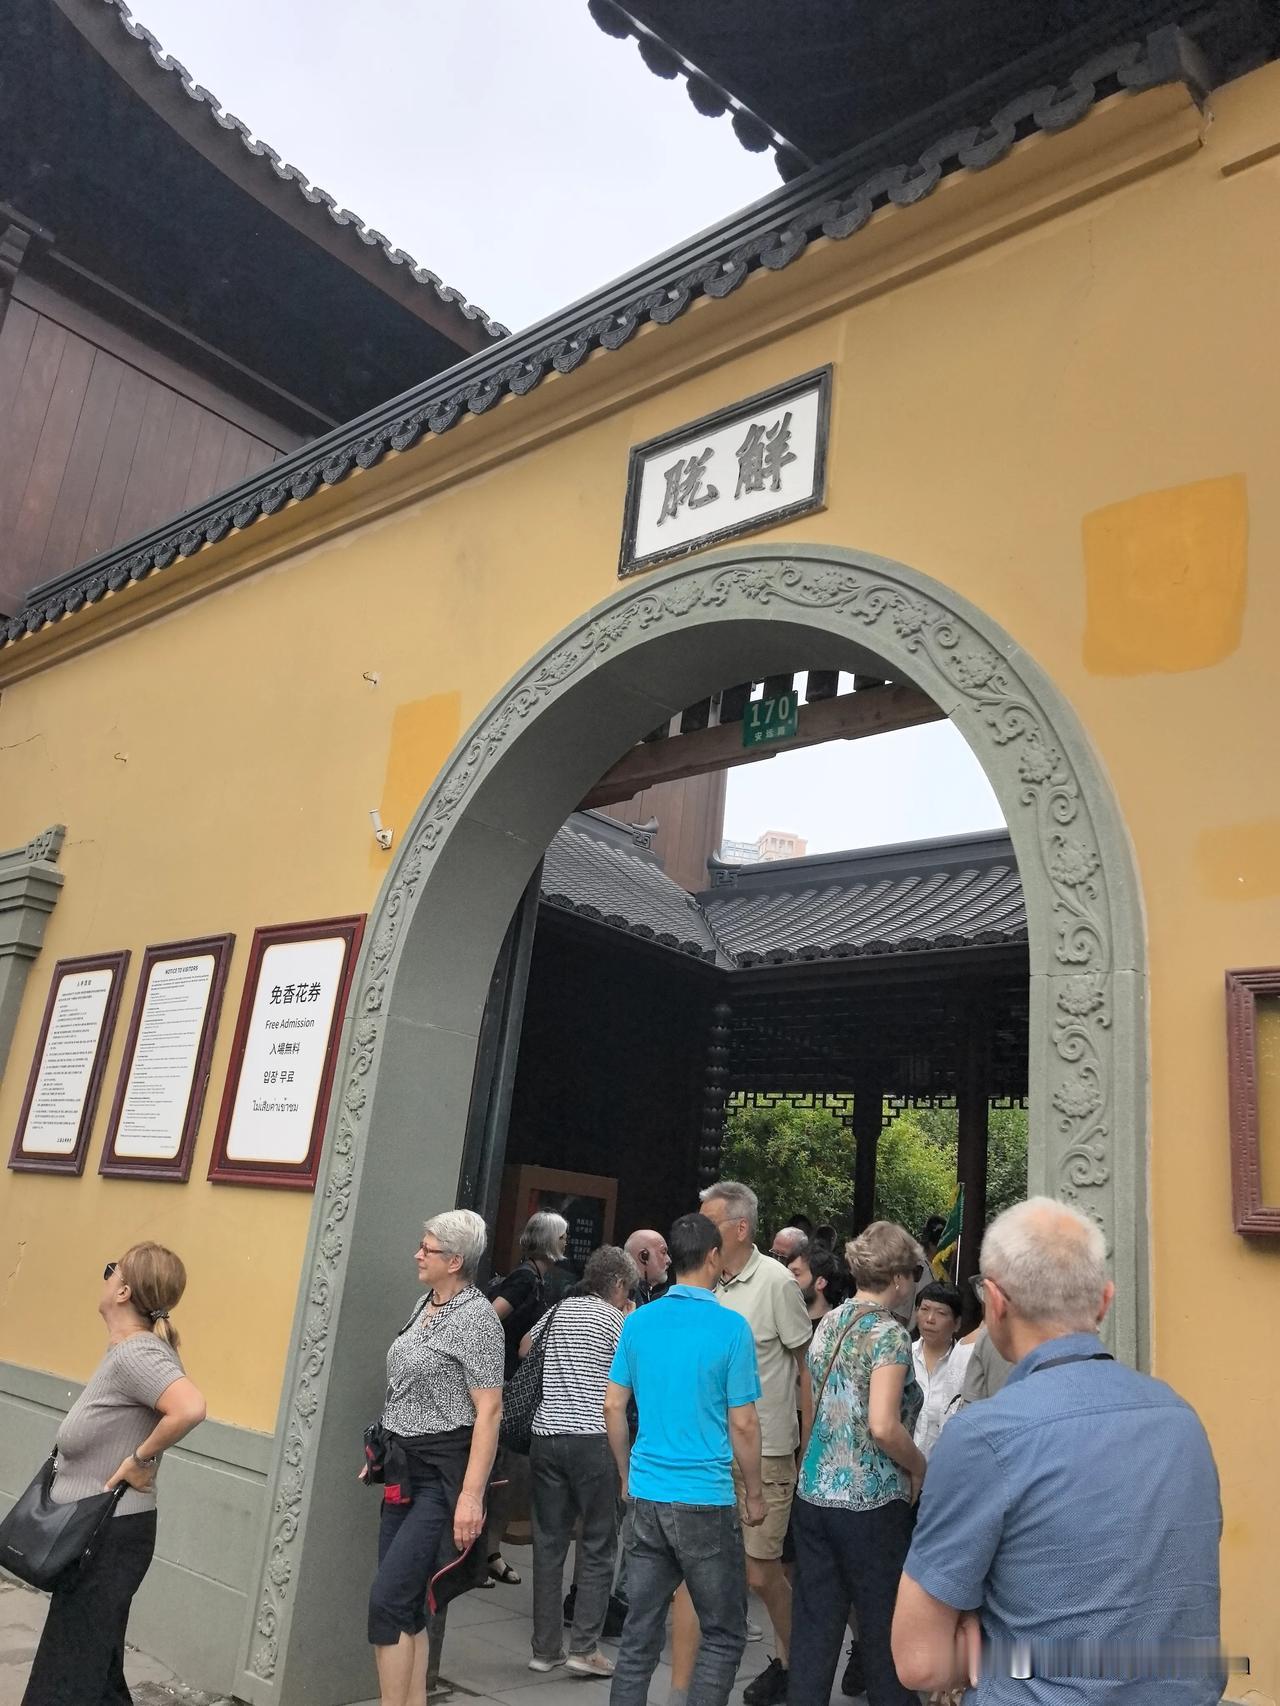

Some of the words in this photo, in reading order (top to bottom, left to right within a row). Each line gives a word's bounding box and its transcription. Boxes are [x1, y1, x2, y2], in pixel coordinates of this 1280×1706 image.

[750, 696, 789, 727] 170
[269, 981, 321, 1005] 免香花券
[265, 1019, 279, 1030] Free
[280, 1018, 315, 1029] Admission
[269, 1042, 300, 1055] 入場無料
[263, 1070, 278, 1084] 입장
[280, 1070, 295, 1083] 무료
